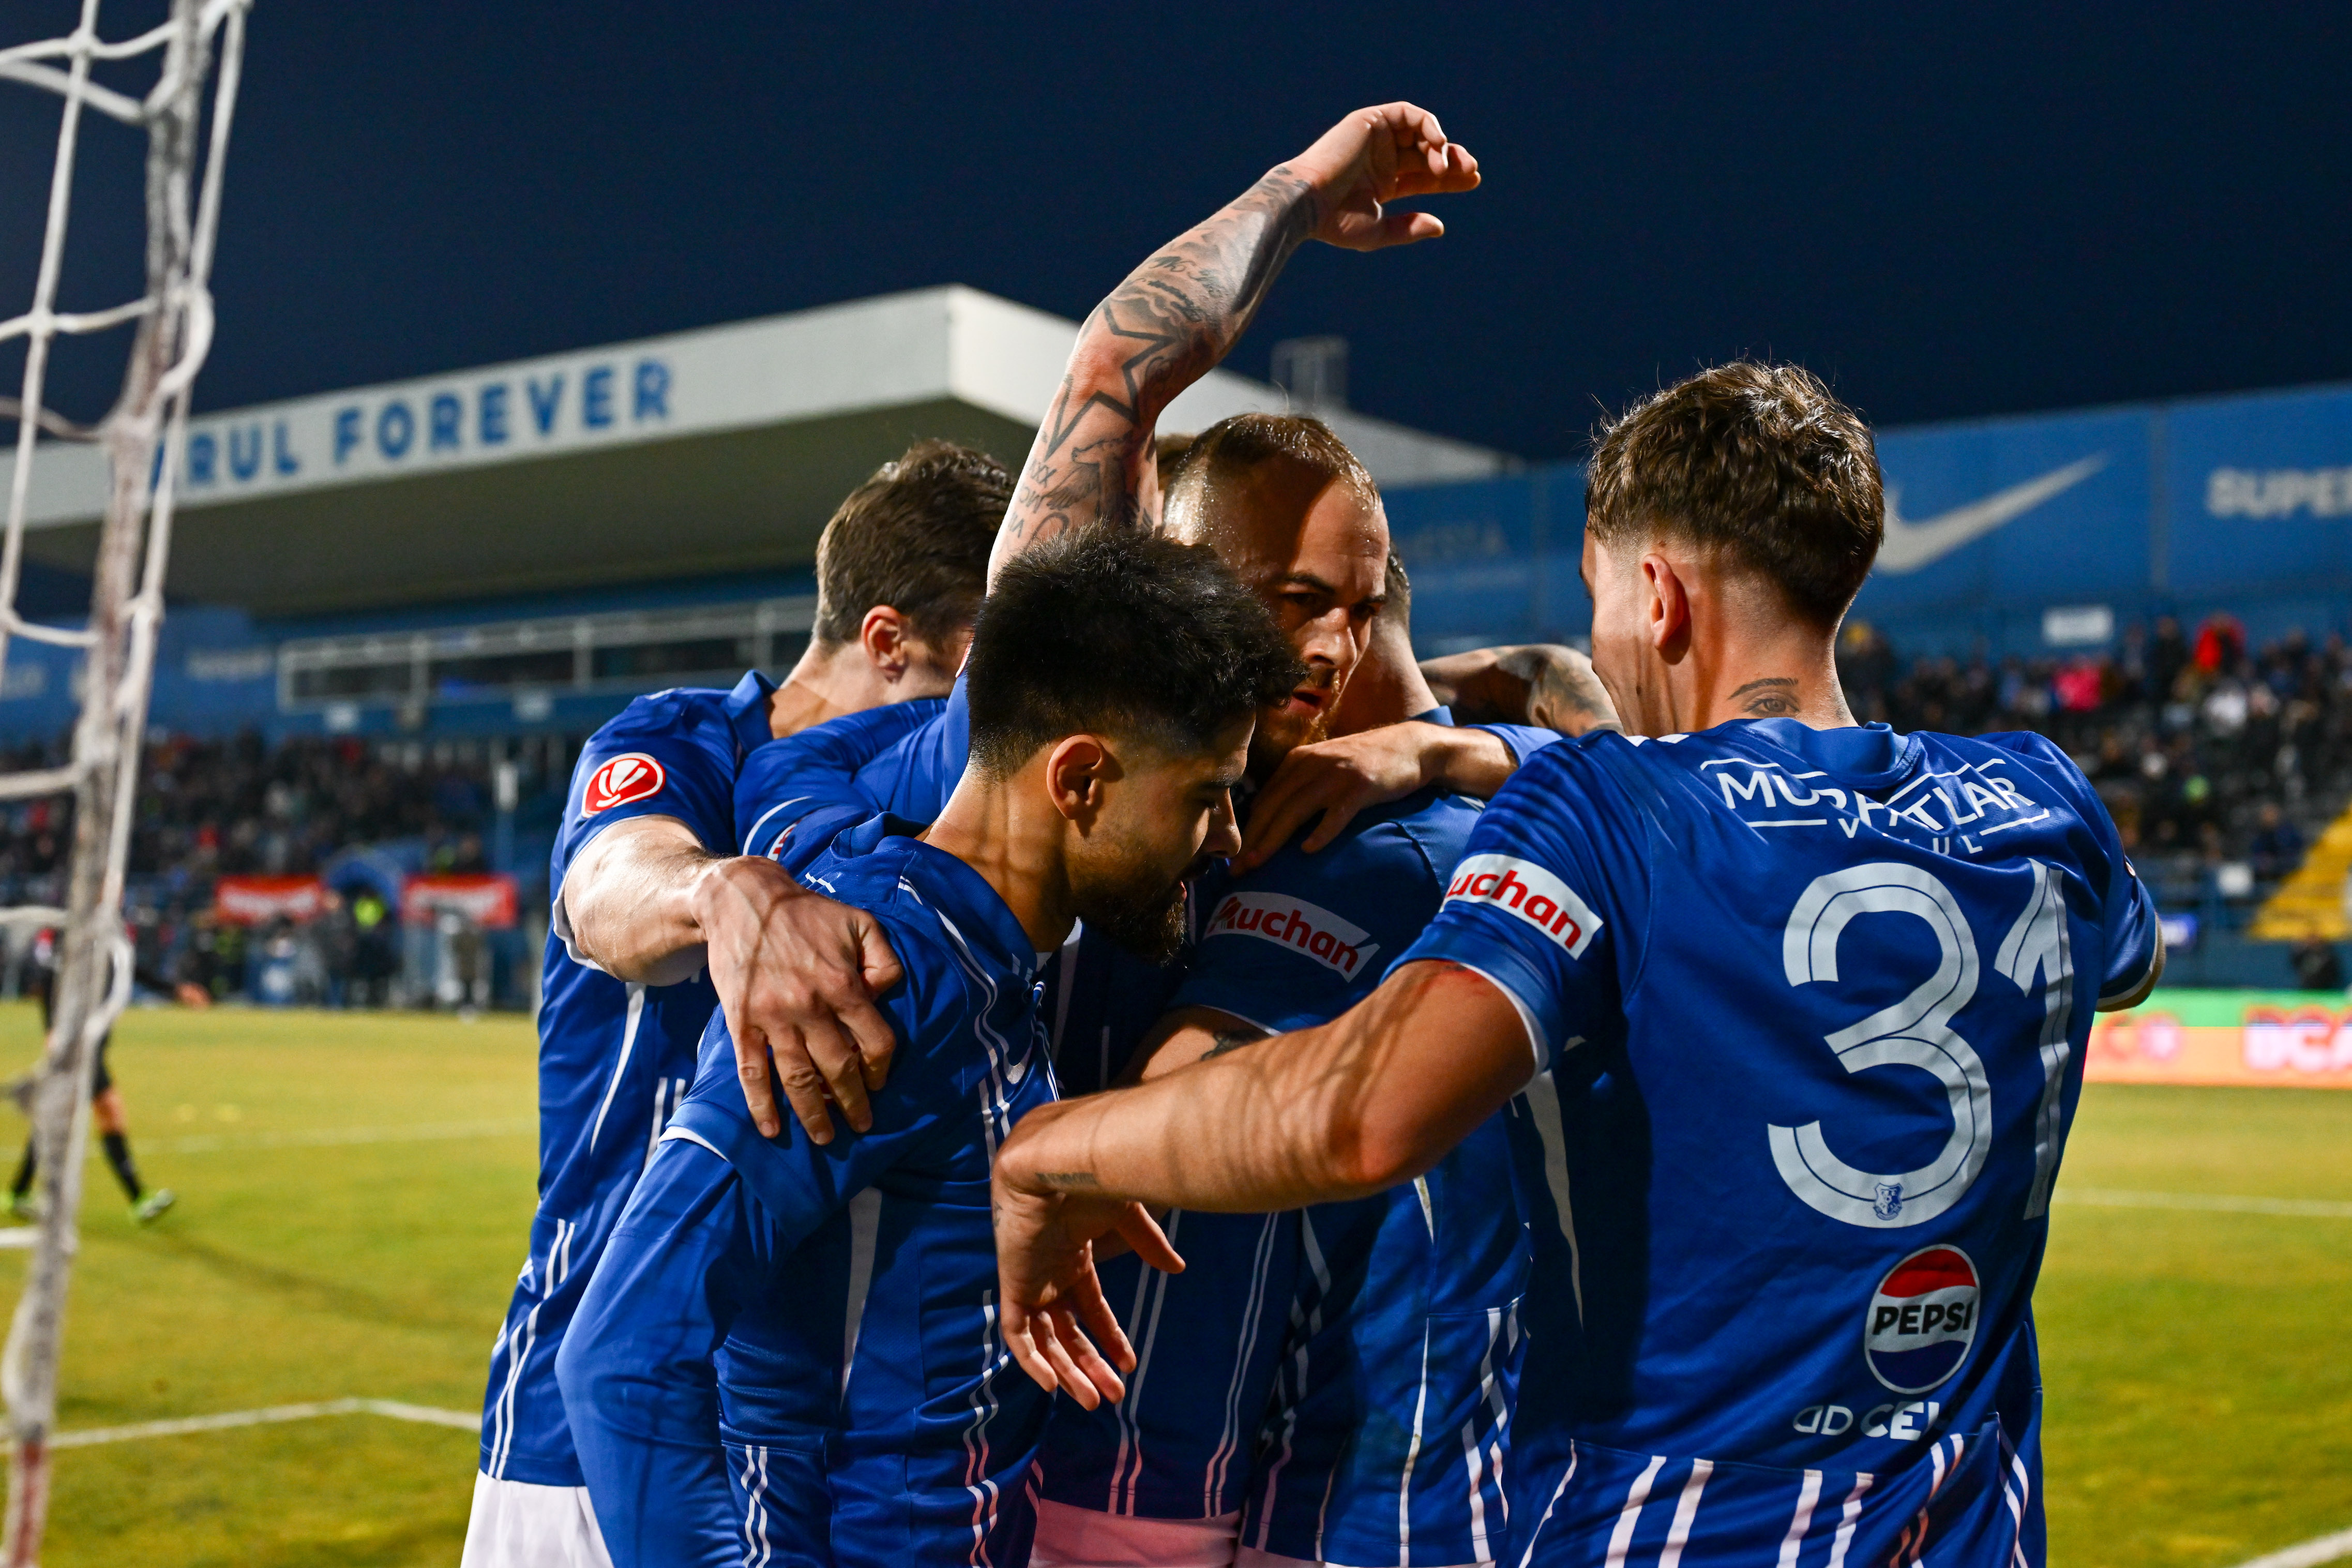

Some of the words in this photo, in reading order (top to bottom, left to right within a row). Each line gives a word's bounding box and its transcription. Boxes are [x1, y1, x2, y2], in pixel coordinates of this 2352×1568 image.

[334, 358, 671, 466] FOREVER
[2207, 466, 2352, 518] SUPE
[1716, 771, 2035, 831] MUFTLAR
[1838, 818, 1983, 856] VUL
[1207, 896, 1359, 973] Auchan
[1446, 870, 1581, 949] uchan
[1767, 857, 2074, 1229] 31
[1872, 1300, 1974, 1335] PEPSI
